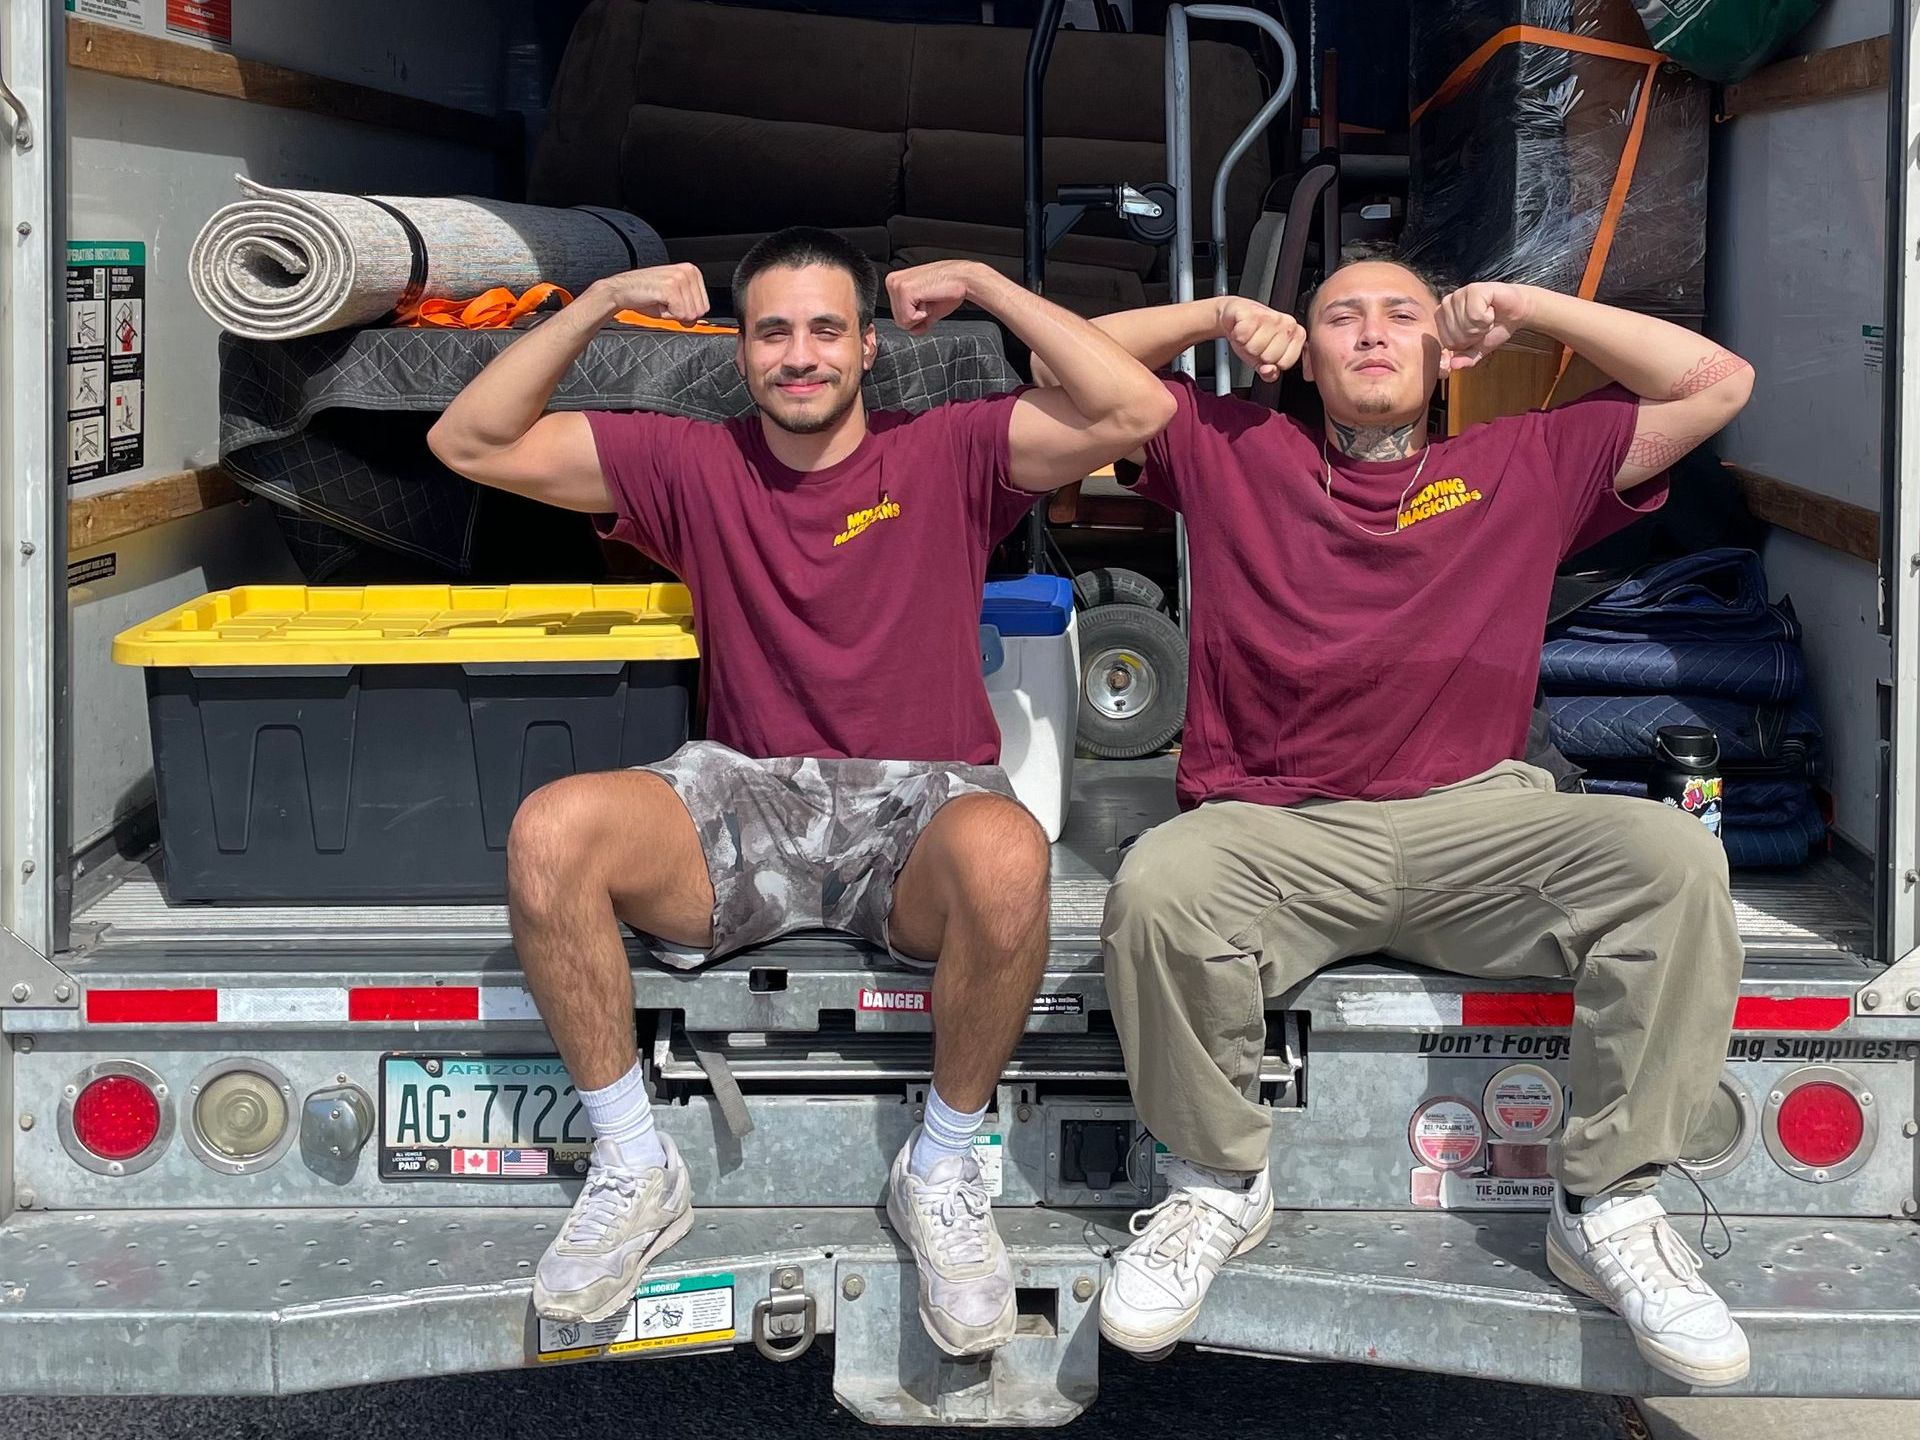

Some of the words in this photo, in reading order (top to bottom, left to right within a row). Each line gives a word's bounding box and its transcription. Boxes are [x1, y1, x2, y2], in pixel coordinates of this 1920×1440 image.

[1410, 477, 1467, 508] MOVING
[1400, 489, 1482, 530] MAGICIANS
[863, 991, 924, 1010] DANGER
[447, 1064, 570, 1076] ARIZONA
[554, 1151, 592, 1161] APPORT
[398, 1161, 421, 1171] PAID
[1475, 1184, 1529, 1196] TIE-DOWN
[1532, 1185, 1555, 1197] ROP
[650, 1282, 681, 1295] HOOKUP
